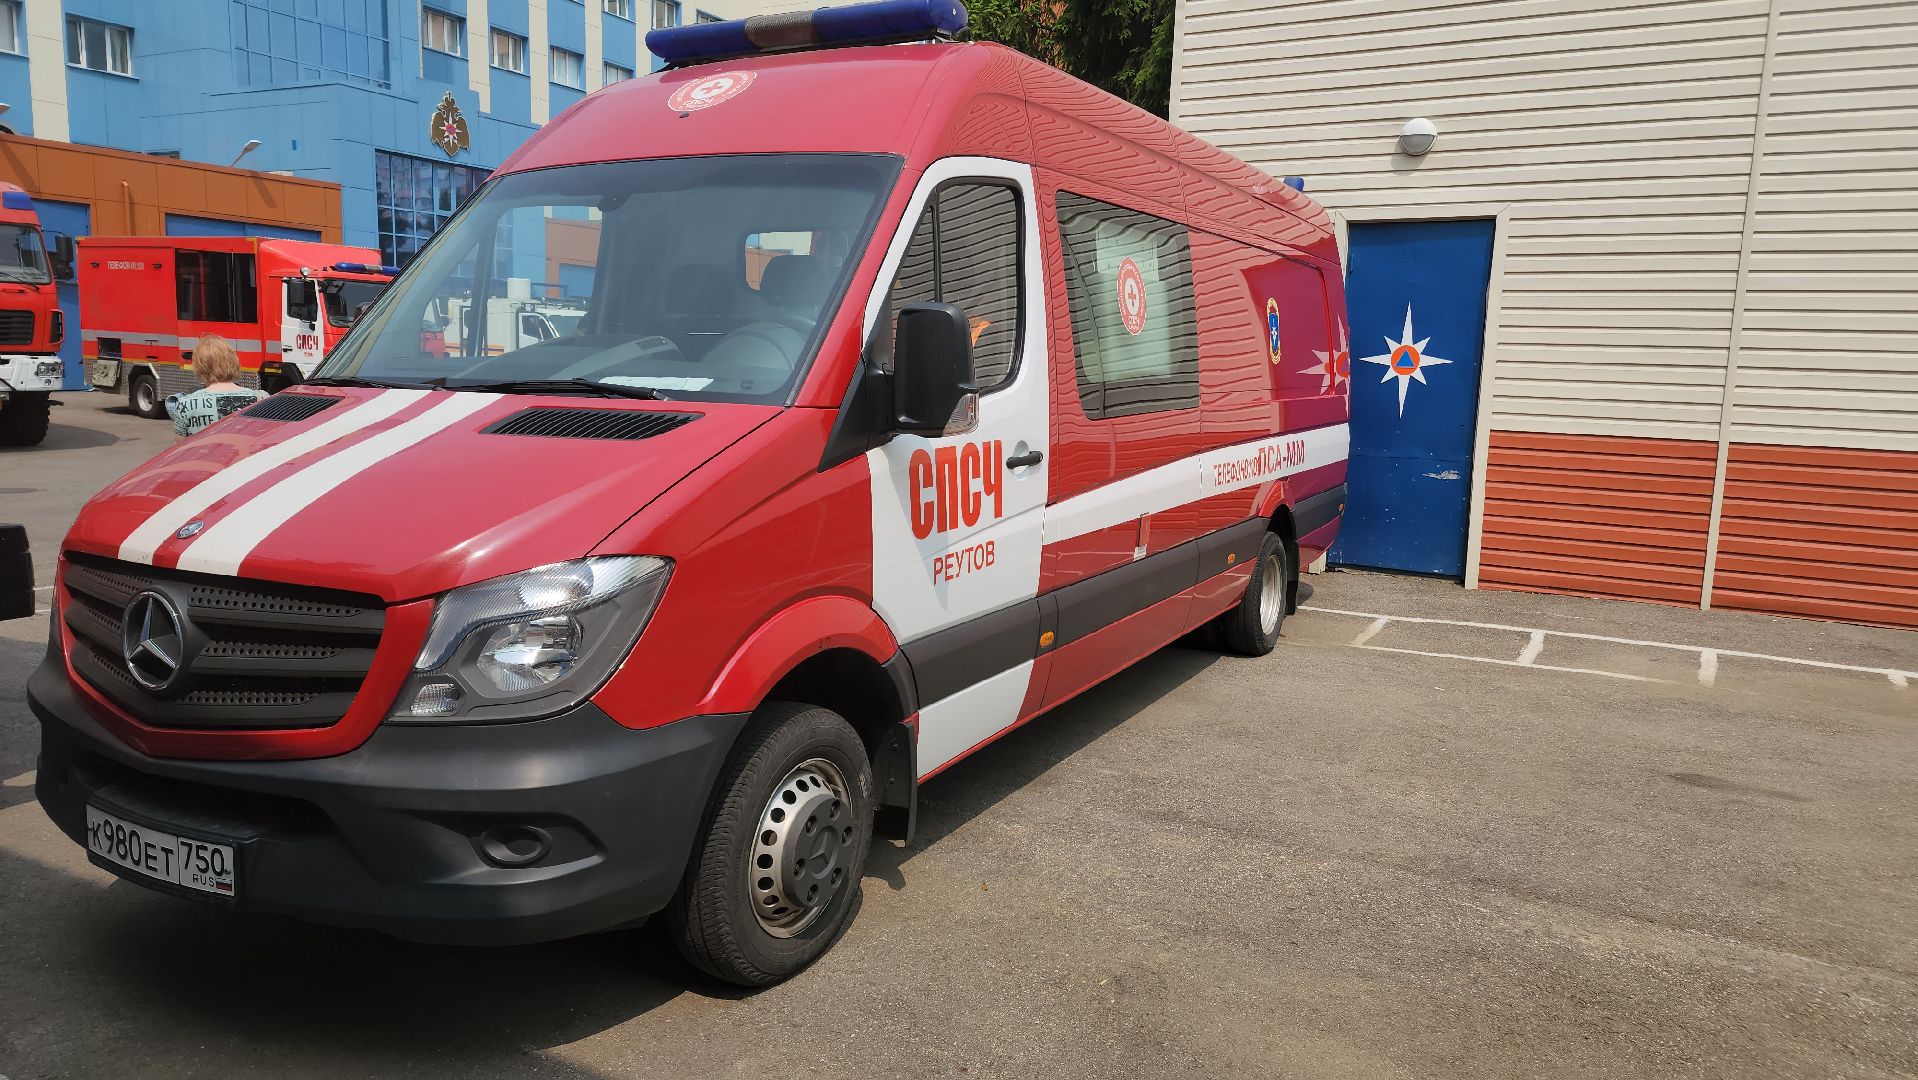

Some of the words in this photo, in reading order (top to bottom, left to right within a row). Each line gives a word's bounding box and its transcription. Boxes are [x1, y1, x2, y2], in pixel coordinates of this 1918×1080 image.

[296, 334, 319, 351] СПСЧ
[202, 397, 213, 409] IS
[1258, 439, 1305, 477] ПСА-ММ
[909, 440, 1003, 540] СПСЧ
[933, 540, 995, 586] РЕУТОВ
[180, 840, 225, 877] 750
[192, 868, 215, 888] RUS
